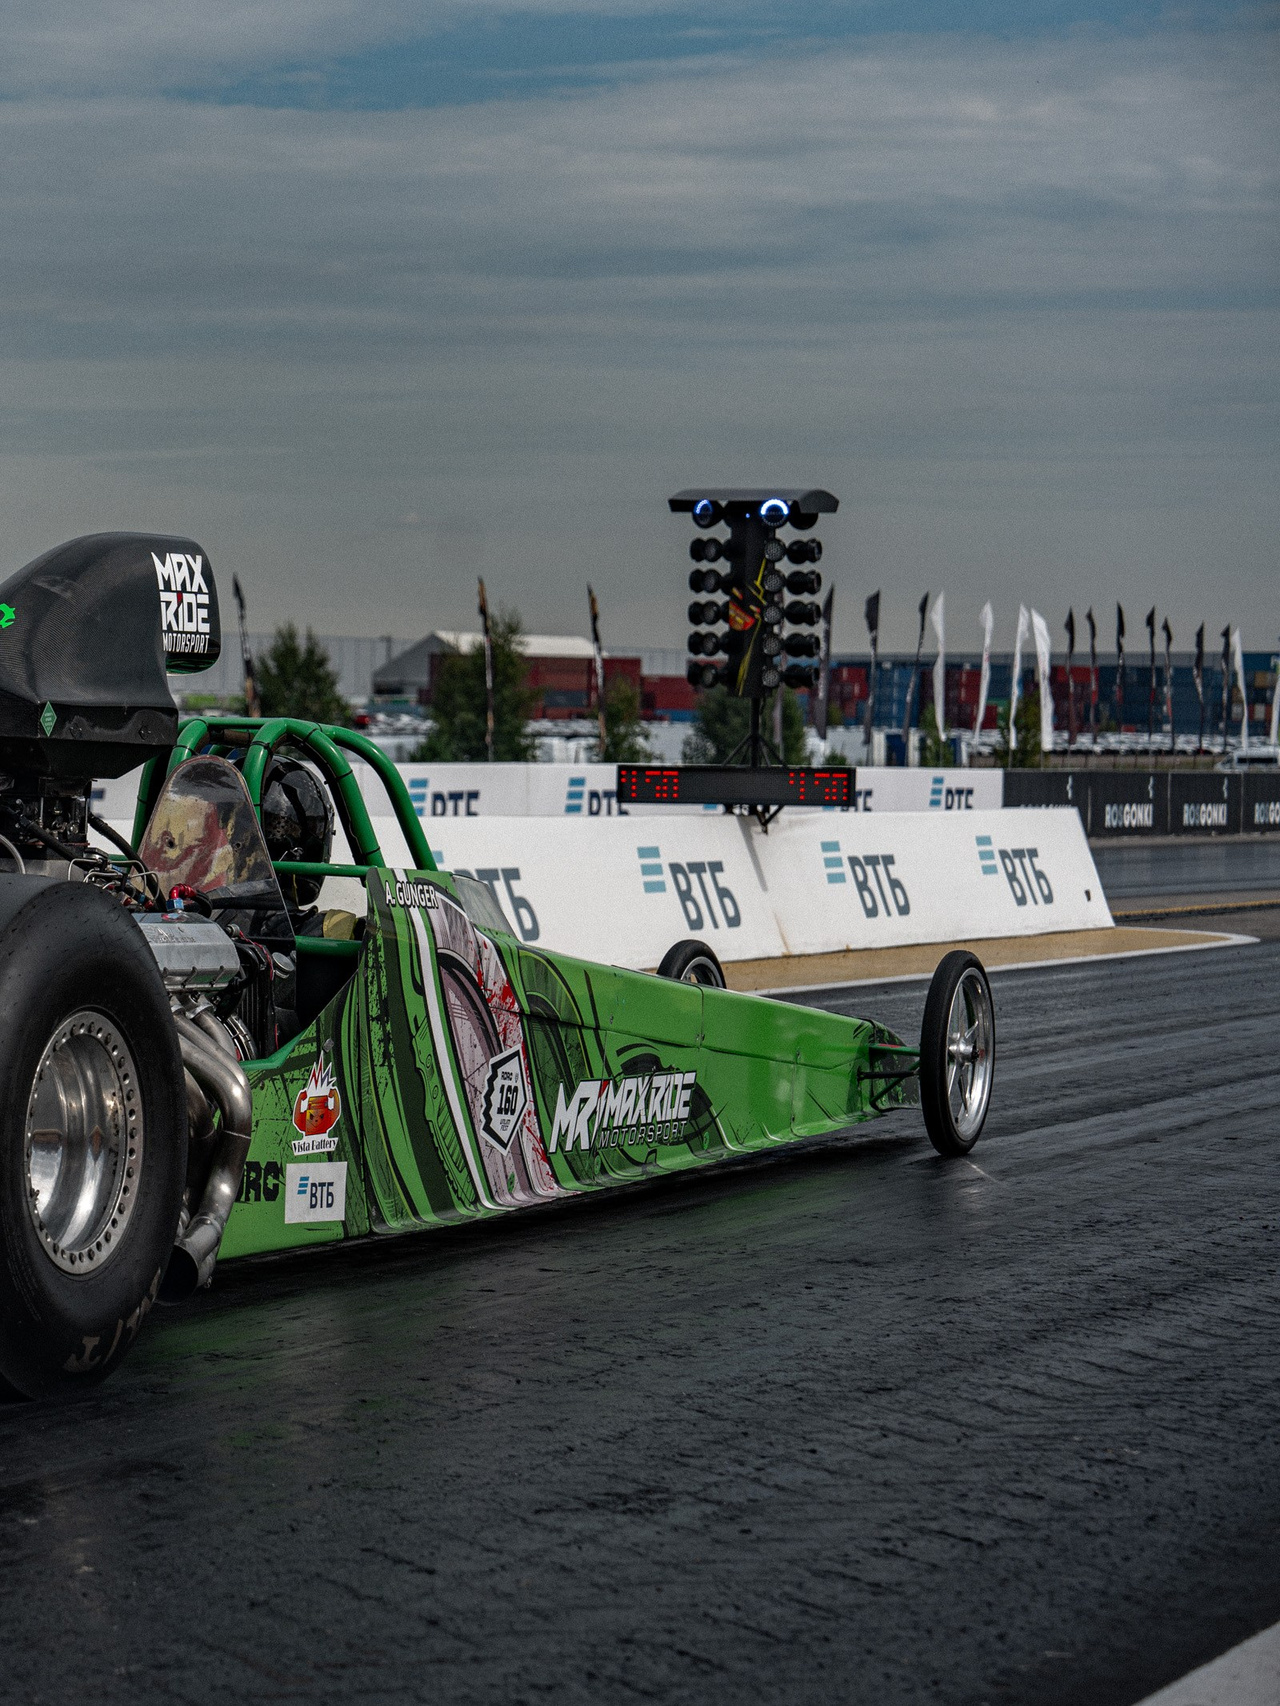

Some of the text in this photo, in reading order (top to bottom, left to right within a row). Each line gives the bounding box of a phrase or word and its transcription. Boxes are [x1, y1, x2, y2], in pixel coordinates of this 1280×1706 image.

[151, 552, 209, 593] MAX
[160, 592, 210, 633] RIDE
[162, 632, 209, 653] MOTORSPORT
[1105, 803, 1153, 828] ROSGONKI
[1183, 803, 1228, 826] ROSGONKI
[847, 854, 910, 918] ВТБ
[998, 848, 1054, 906] ВТБ
[396, 882, 439, 908] GUNGER
[454, 867, 540, 942] ТБ
[669, 860, 741, 931] ВТБ
[497, 1084, 518, 1115] 160
[293, 1138, 336, 1153] Vista Battery
[598, 1120, 688, 1149] MOTORSPORT
[309, 1181, 335, 1209] ВТБ
